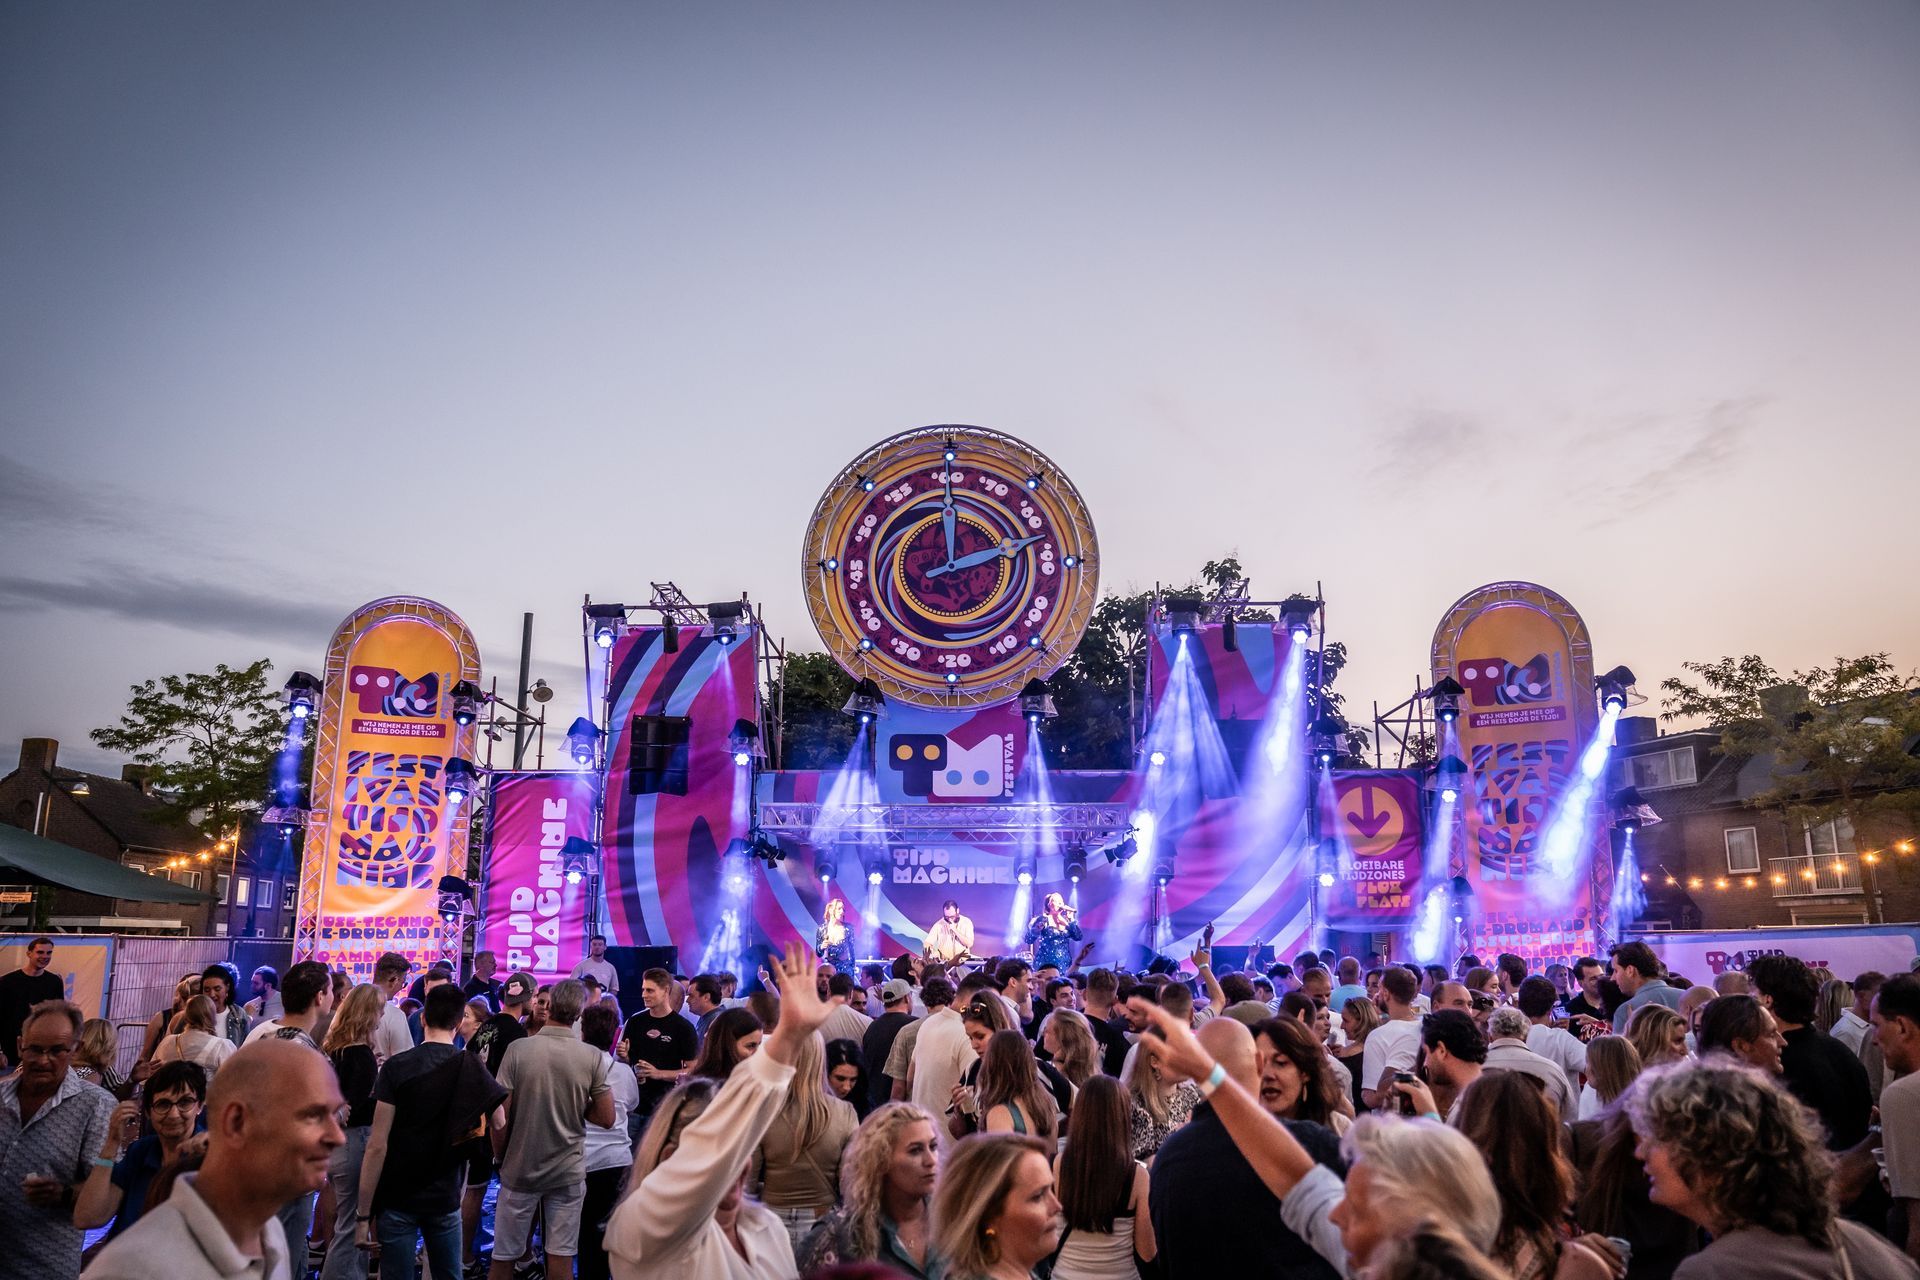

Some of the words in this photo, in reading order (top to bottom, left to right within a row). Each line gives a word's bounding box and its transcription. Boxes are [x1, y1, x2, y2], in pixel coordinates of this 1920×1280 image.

[377, 721, 401, 729] NEMEN
[347, 750, 443, 779] FEST
[1004, 733, 1014, 797] FESTIVAL
[344, 776, 440, 806] IVAL
[342, 804, 438, 834] TIJD
[1476, 796, 1553, 825] TIJ
[339, 832, 436, 863] MAC
[1478, 825, 1539, 855] MA
[893, 849, 950, 866] TIJD
[1341, 861, 1405, 871] LOEIBARE
[533, 798, 567, 974] MACHINE
[893, 866, 1010, 884] MACHINE
[1340, 870, 1405, 881] TIJDZONES
[393, 928, 430, 939] AND
[506, 887, 535, 972] TIJD
